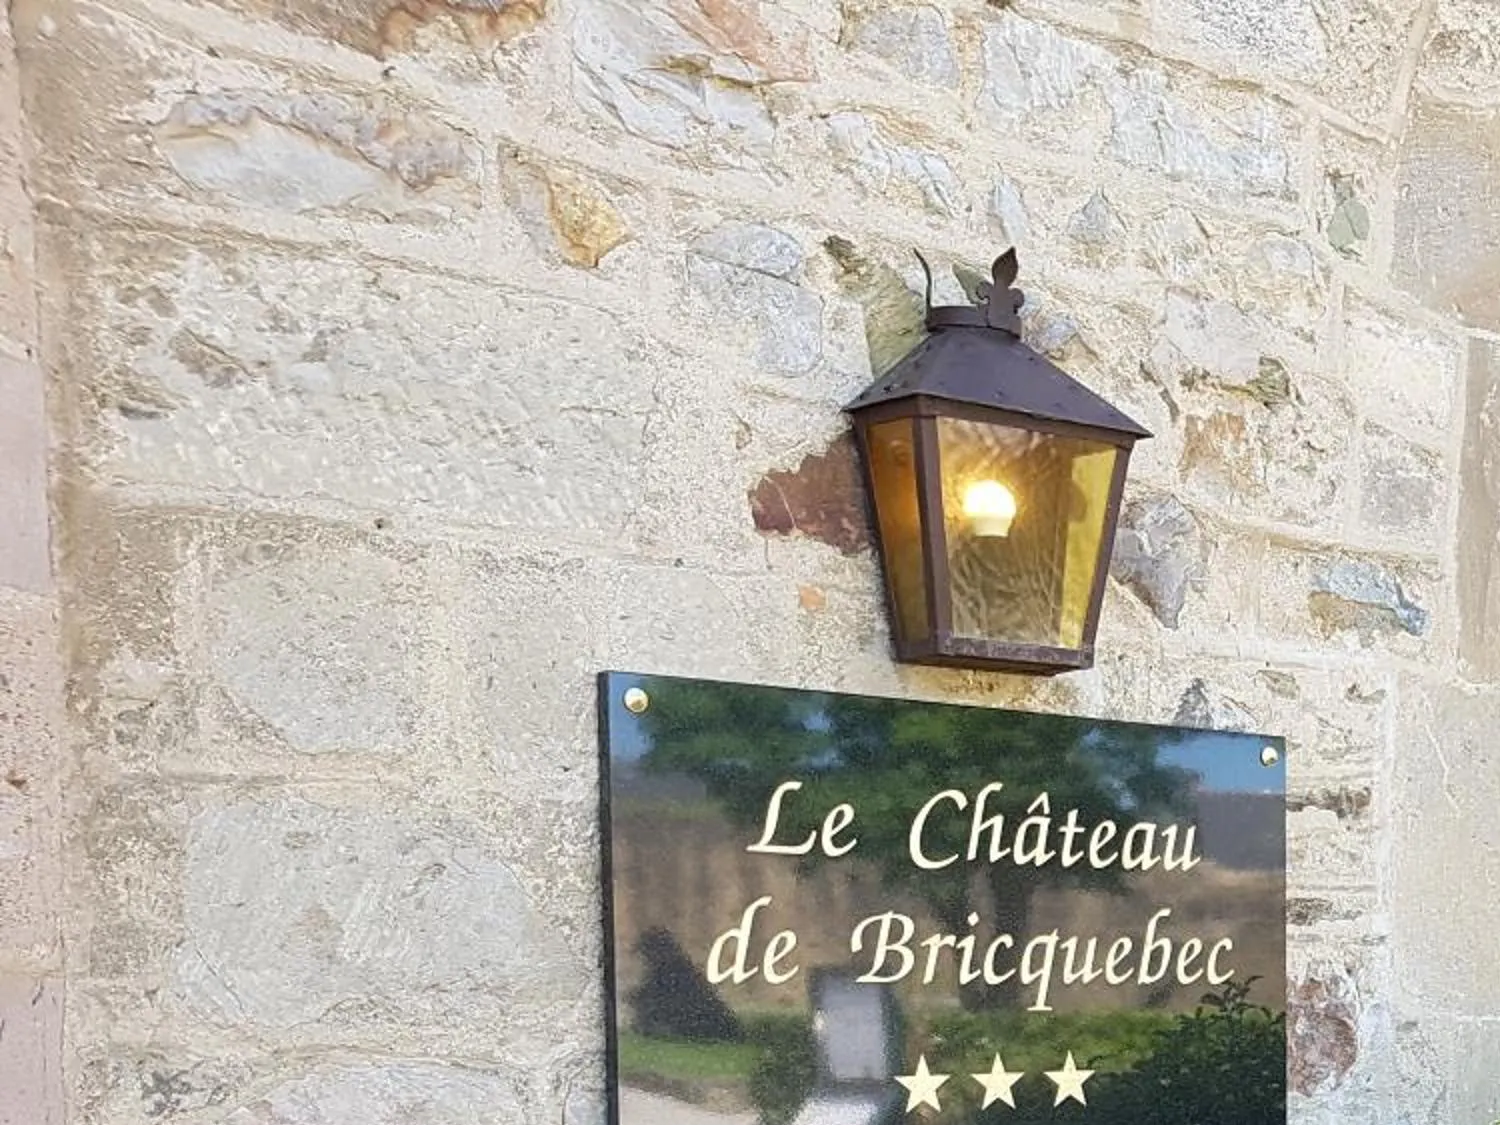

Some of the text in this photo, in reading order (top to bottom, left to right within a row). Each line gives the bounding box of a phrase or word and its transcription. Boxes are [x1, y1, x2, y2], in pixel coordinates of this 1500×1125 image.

[746, 781, 1201, 872] Le Château
[706, 895, 1235, 1011] de Bricquebec
